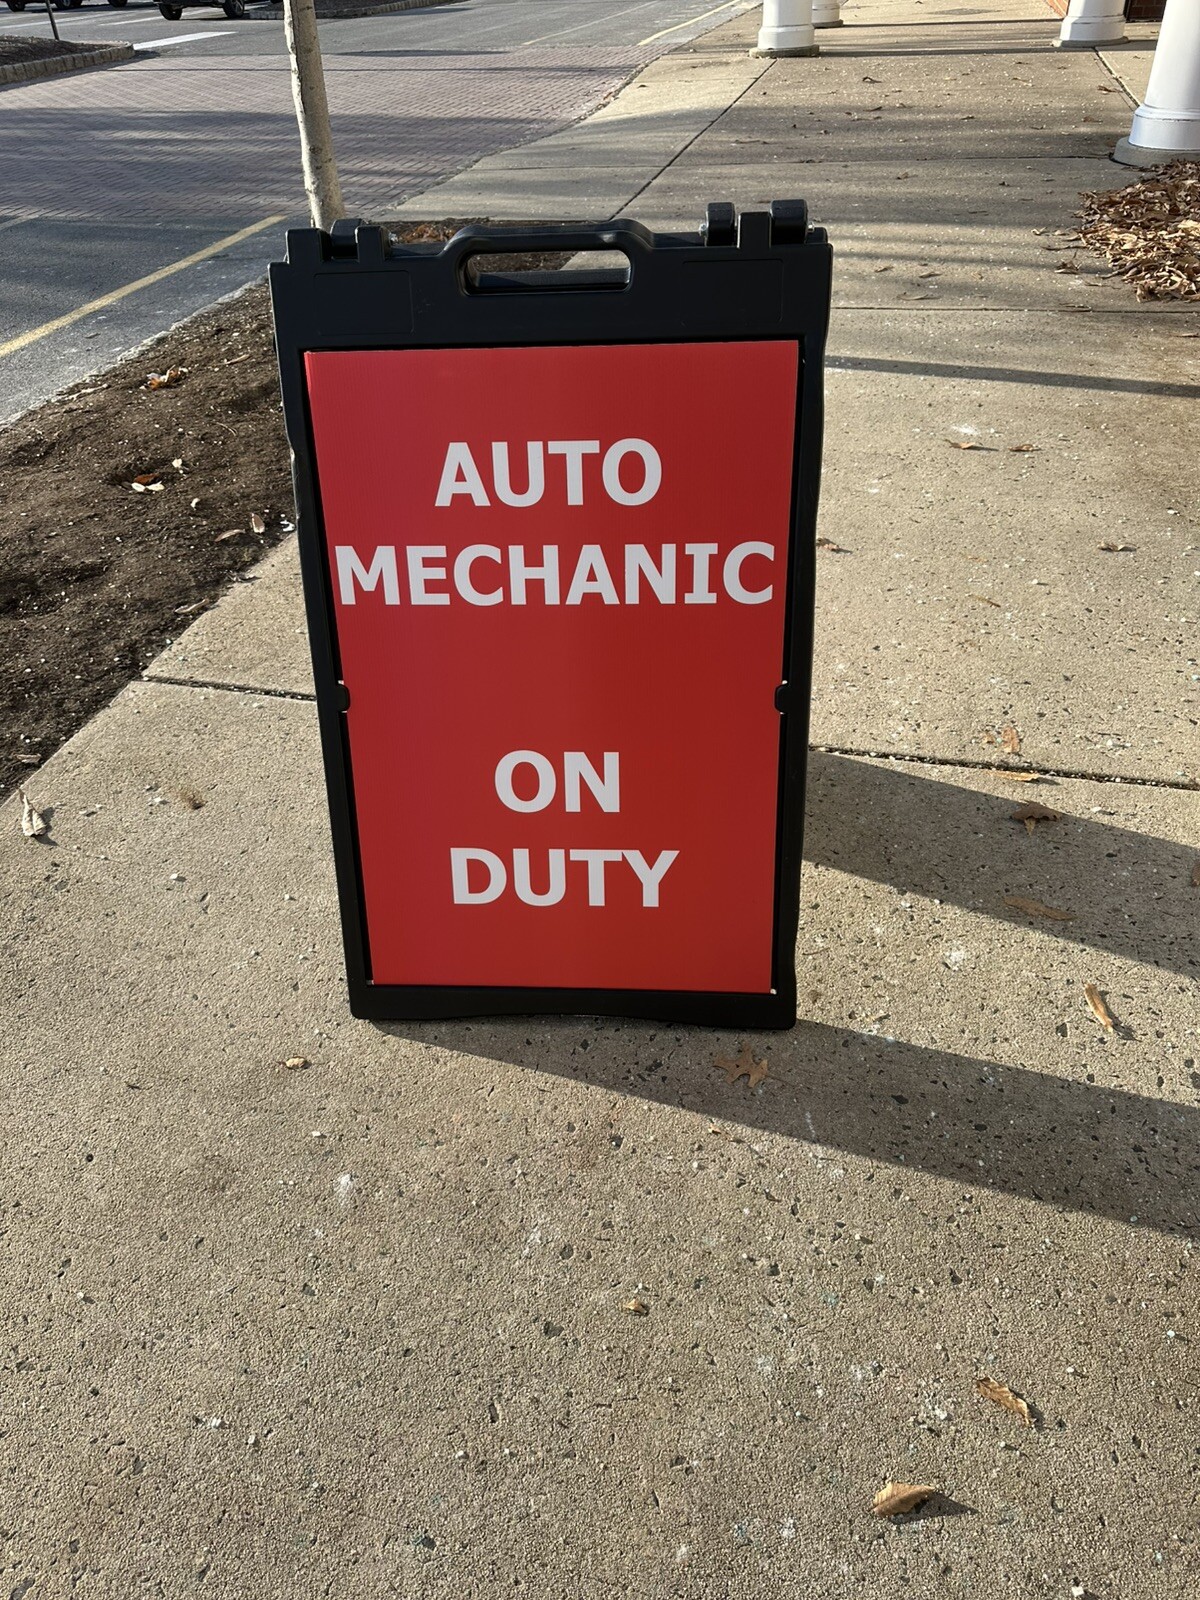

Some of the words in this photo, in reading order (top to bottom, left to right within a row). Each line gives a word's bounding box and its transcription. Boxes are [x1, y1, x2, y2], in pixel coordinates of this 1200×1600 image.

[434, 438, 663, 508] AUTO
[335, 541, 776, 606] MECHANIC
[494, 750, 621, 814] ON
[450, 847, 680, 908] DUTY
